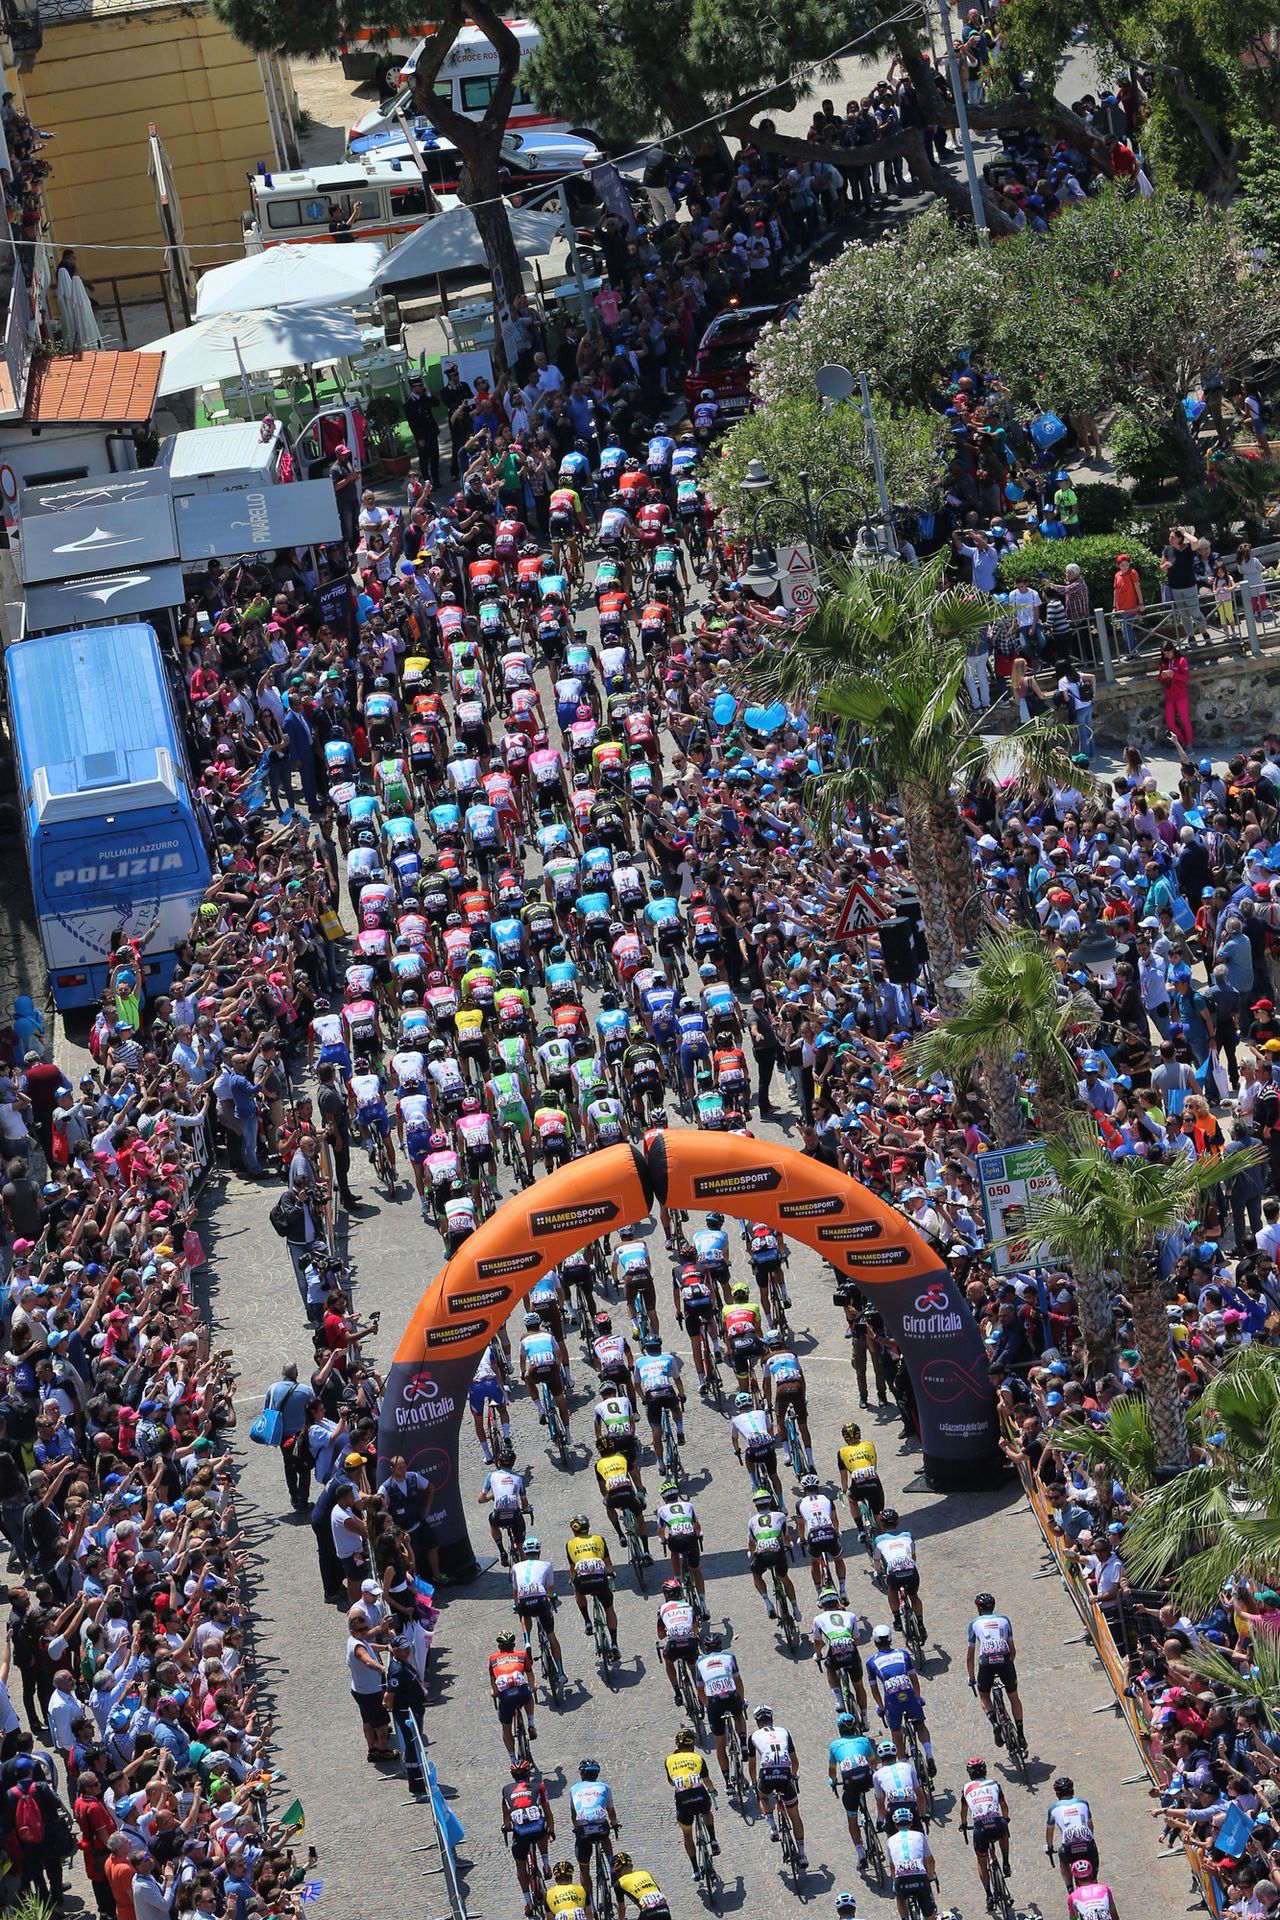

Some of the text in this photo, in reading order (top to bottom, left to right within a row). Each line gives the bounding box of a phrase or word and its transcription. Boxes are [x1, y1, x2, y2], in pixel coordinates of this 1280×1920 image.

[246, 493, 271, 543] PINARELLO
[796, 590, 808, 600] 20
[99, 840, 179, 860] PULLMAN AZZURRO
[54, 852, 183, 888] POLIZIA
[708, 1172, 768, 1188] NAMEDSPORT
[716, 1184, 756, 1194] SUPERFOOD
[790, 1200, 835, 1212] NAMEDSPORT
[795, 1208, 826, 1216] SUPERFOOD
[544, 1206, 606, 1224] NAMEDSPORT
[552, 1217, 593, 1230] SUPERFOOD
[828, 1224, 874, 1236] NAMEDSPORT
[834, 1232, 864, 1240] SUPERFOOD
[857, 1250, 903, 1262] NAMEDSPORT
[488, 1256, 534, 1270] NAMEDSPORT
[494, 1264, 524, 1274] SUPERFOOD
[458, 1290, 503, 1306] NAMEDSPORT
[463, 1299, 494, 1309] SUPERFOOD
[903, 1312, 962, 1334] Giro d'Italia
[436, 1323, 481, 1339] NAMEDSPORT
[442, 1332, 472, 1342] SUPERFOOD
[396, 1397, 455, 1426] Giro d'Italia
[977, 1421, 988, 1432] Sport
[668, 1610, 688, 1618] UAE
[708, 1679, 721, 1691] 106
[764, 1754, 770, 1762] 5
[970, 1788, 992, 1798] UAE
[1081, 1886, 1100, 1897] EF
